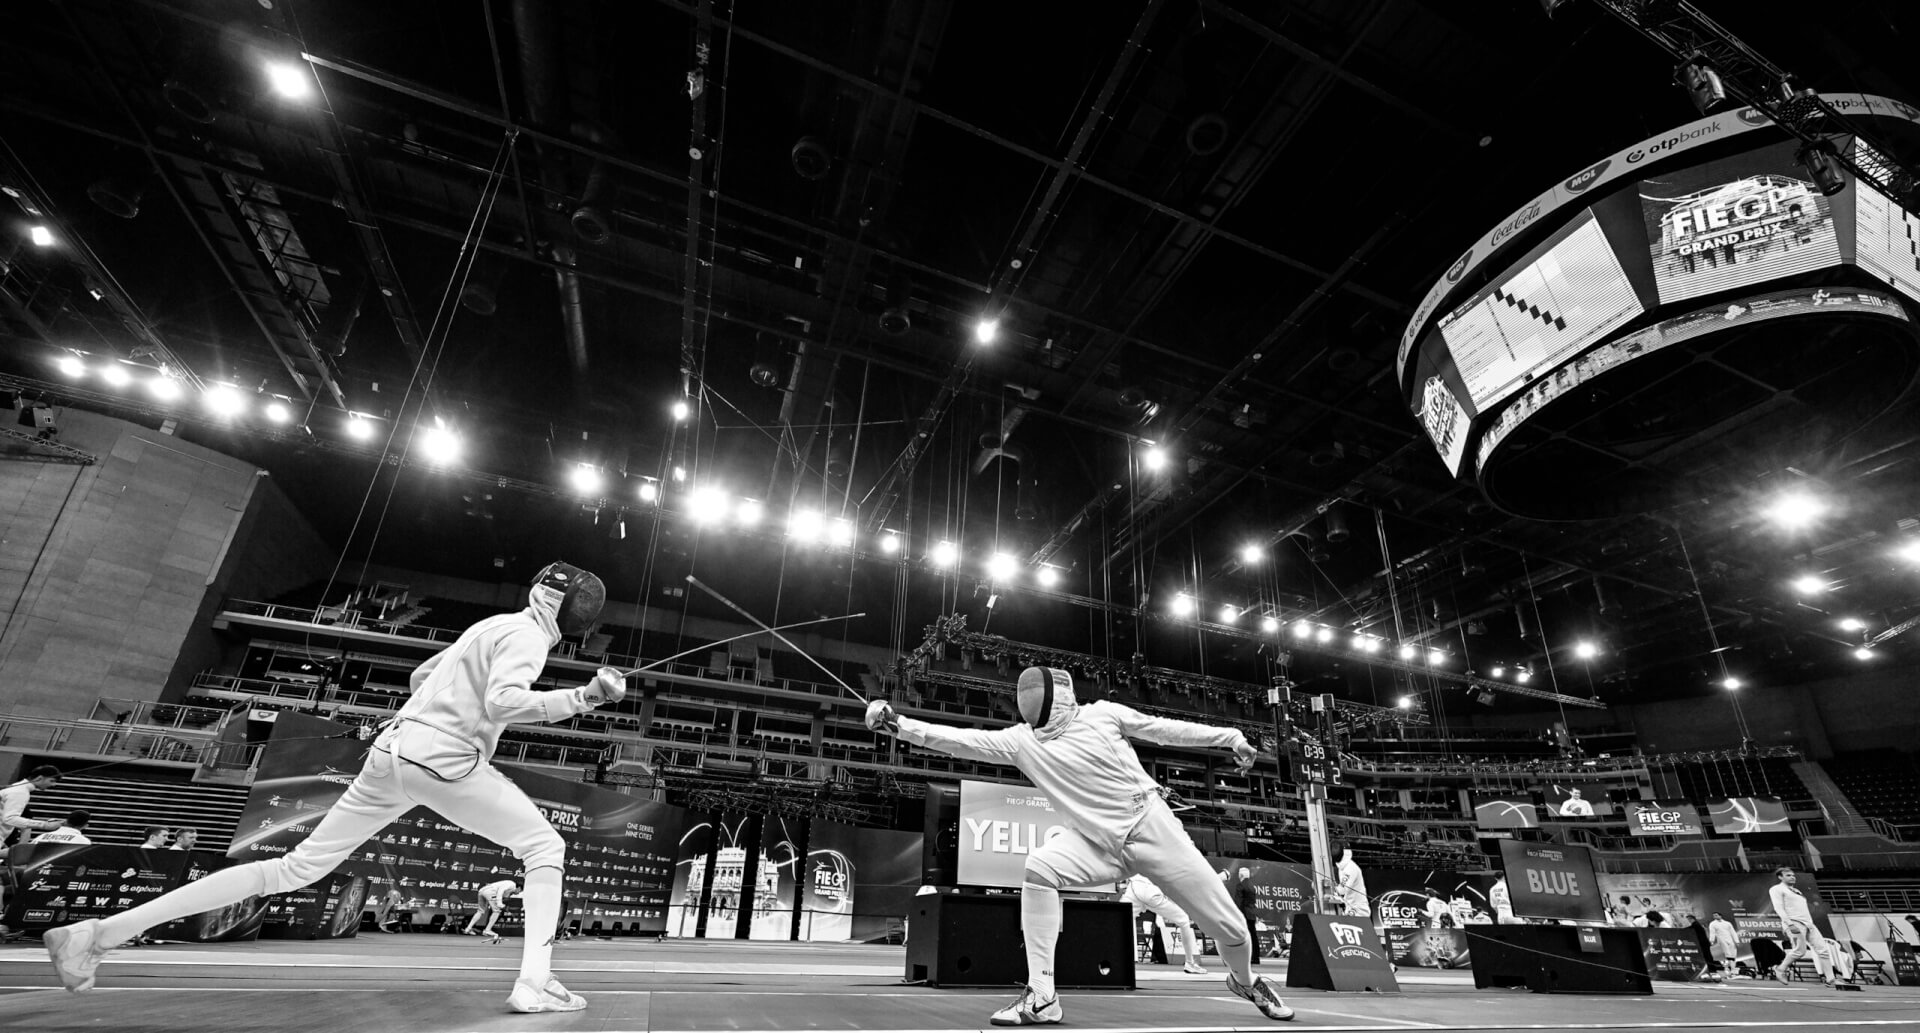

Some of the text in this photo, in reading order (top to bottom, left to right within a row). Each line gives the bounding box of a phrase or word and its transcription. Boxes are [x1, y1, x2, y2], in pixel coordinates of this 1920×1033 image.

[1648, 122, 1721, 154] otpbank
[1571, 170, 1597, 188] MOL
[1679, 222, 1783, 256] GRAND PRIX
[1449, 260, 1465, 279] MOL
[1304, 745, 1325, 759] 0:39
[1301, 764, 1341, 785] 4 2
[1026, 799, 1050, 808] GRAND
[551, 810, 580, 827] PRIX
[625, 829, 653, 841] NINE CITIES
[626, 821, 655, 834] ONE SERIES,
[1526, 868, 1581, 897] BLUE
[1272, 886, 1303, 900] SERIES,
[1275, 900, 1302, 912] CITIES
[1738, 920, 1782, 929] BUDAPES
[1328, 921, 1364, 947] PBT
[1583, 935, 1597, 943] BLUE
